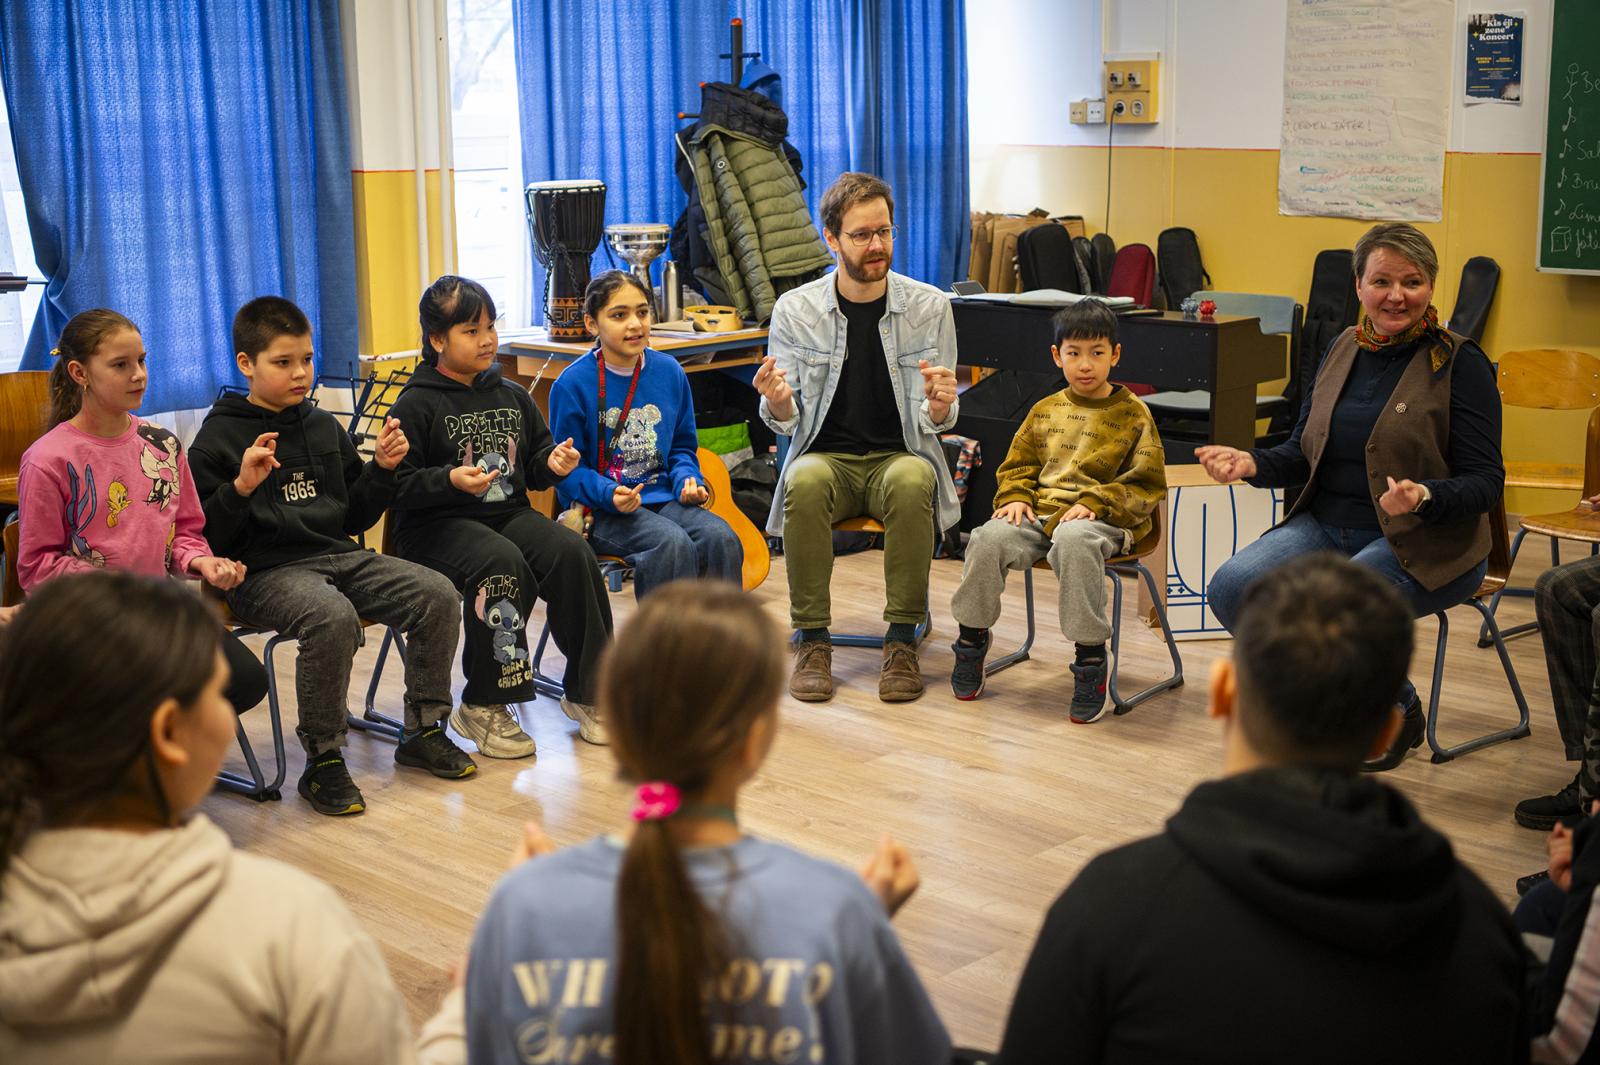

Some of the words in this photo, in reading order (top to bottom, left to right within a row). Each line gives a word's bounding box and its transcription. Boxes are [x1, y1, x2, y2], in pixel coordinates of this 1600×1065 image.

[1480, 33, 1514, 41] Koncert
[445, 408, 521, 439] PRETTY
[292, 472, 304, 480] THE
[281, 480, 317, 502] 1965
[512, 957, 609, 1009] WH
